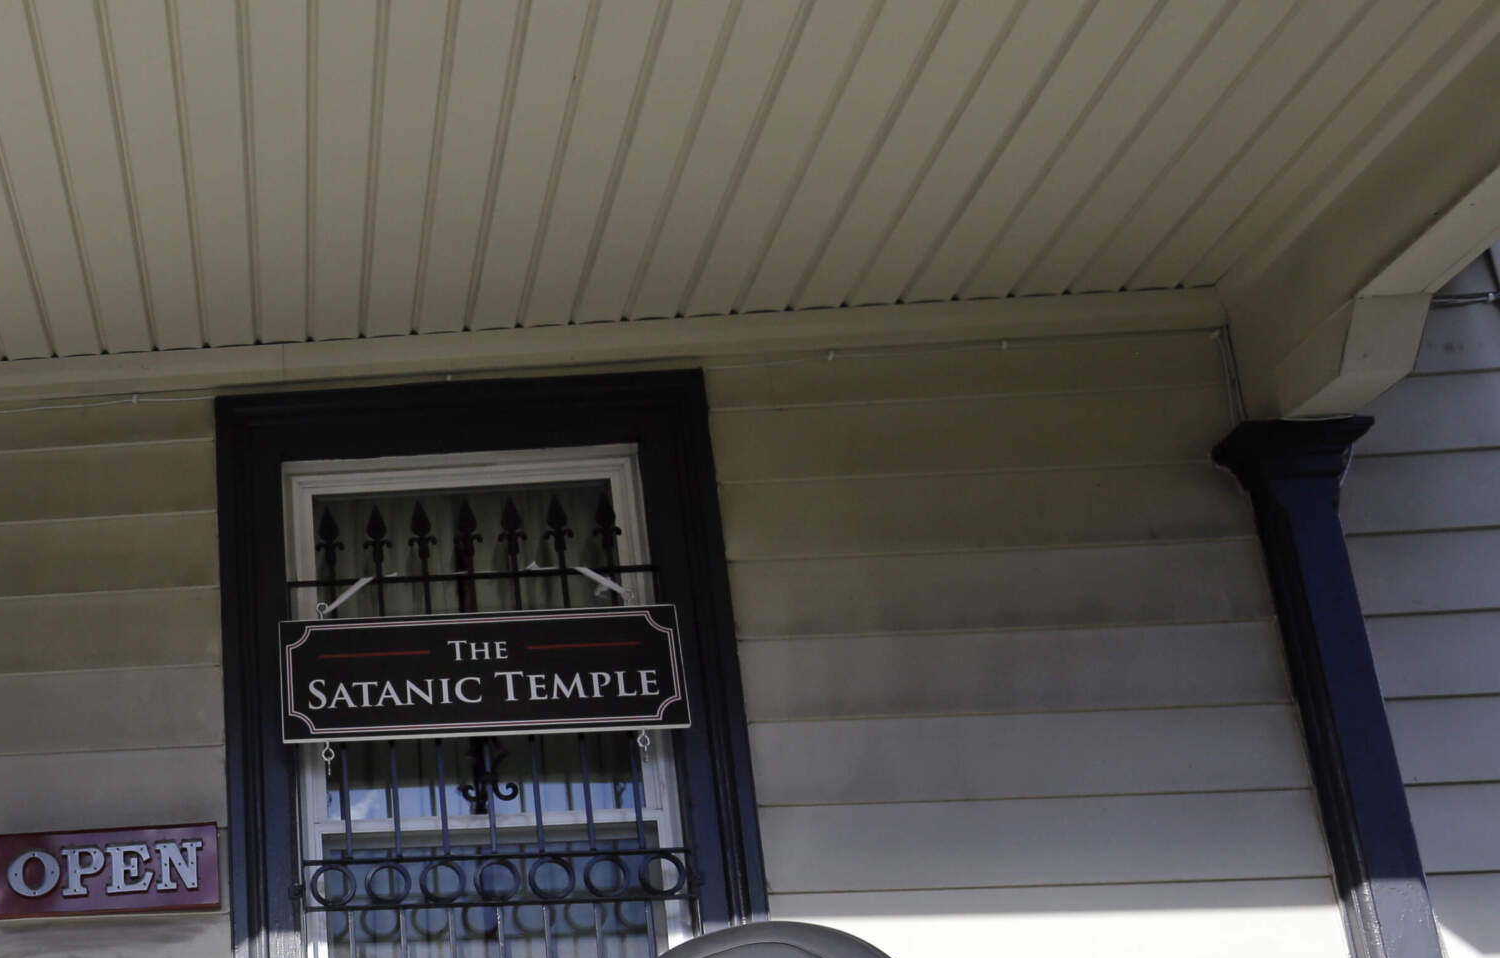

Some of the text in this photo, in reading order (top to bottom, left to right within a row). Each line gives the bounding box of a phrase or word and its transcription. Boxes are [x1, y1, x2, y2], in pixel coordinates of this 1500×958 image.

[447, 639, 509, 662] THE
[307, 668, 661, 711] SATANIC TEMPLE
[7, 839, 204, 897] OPEN
